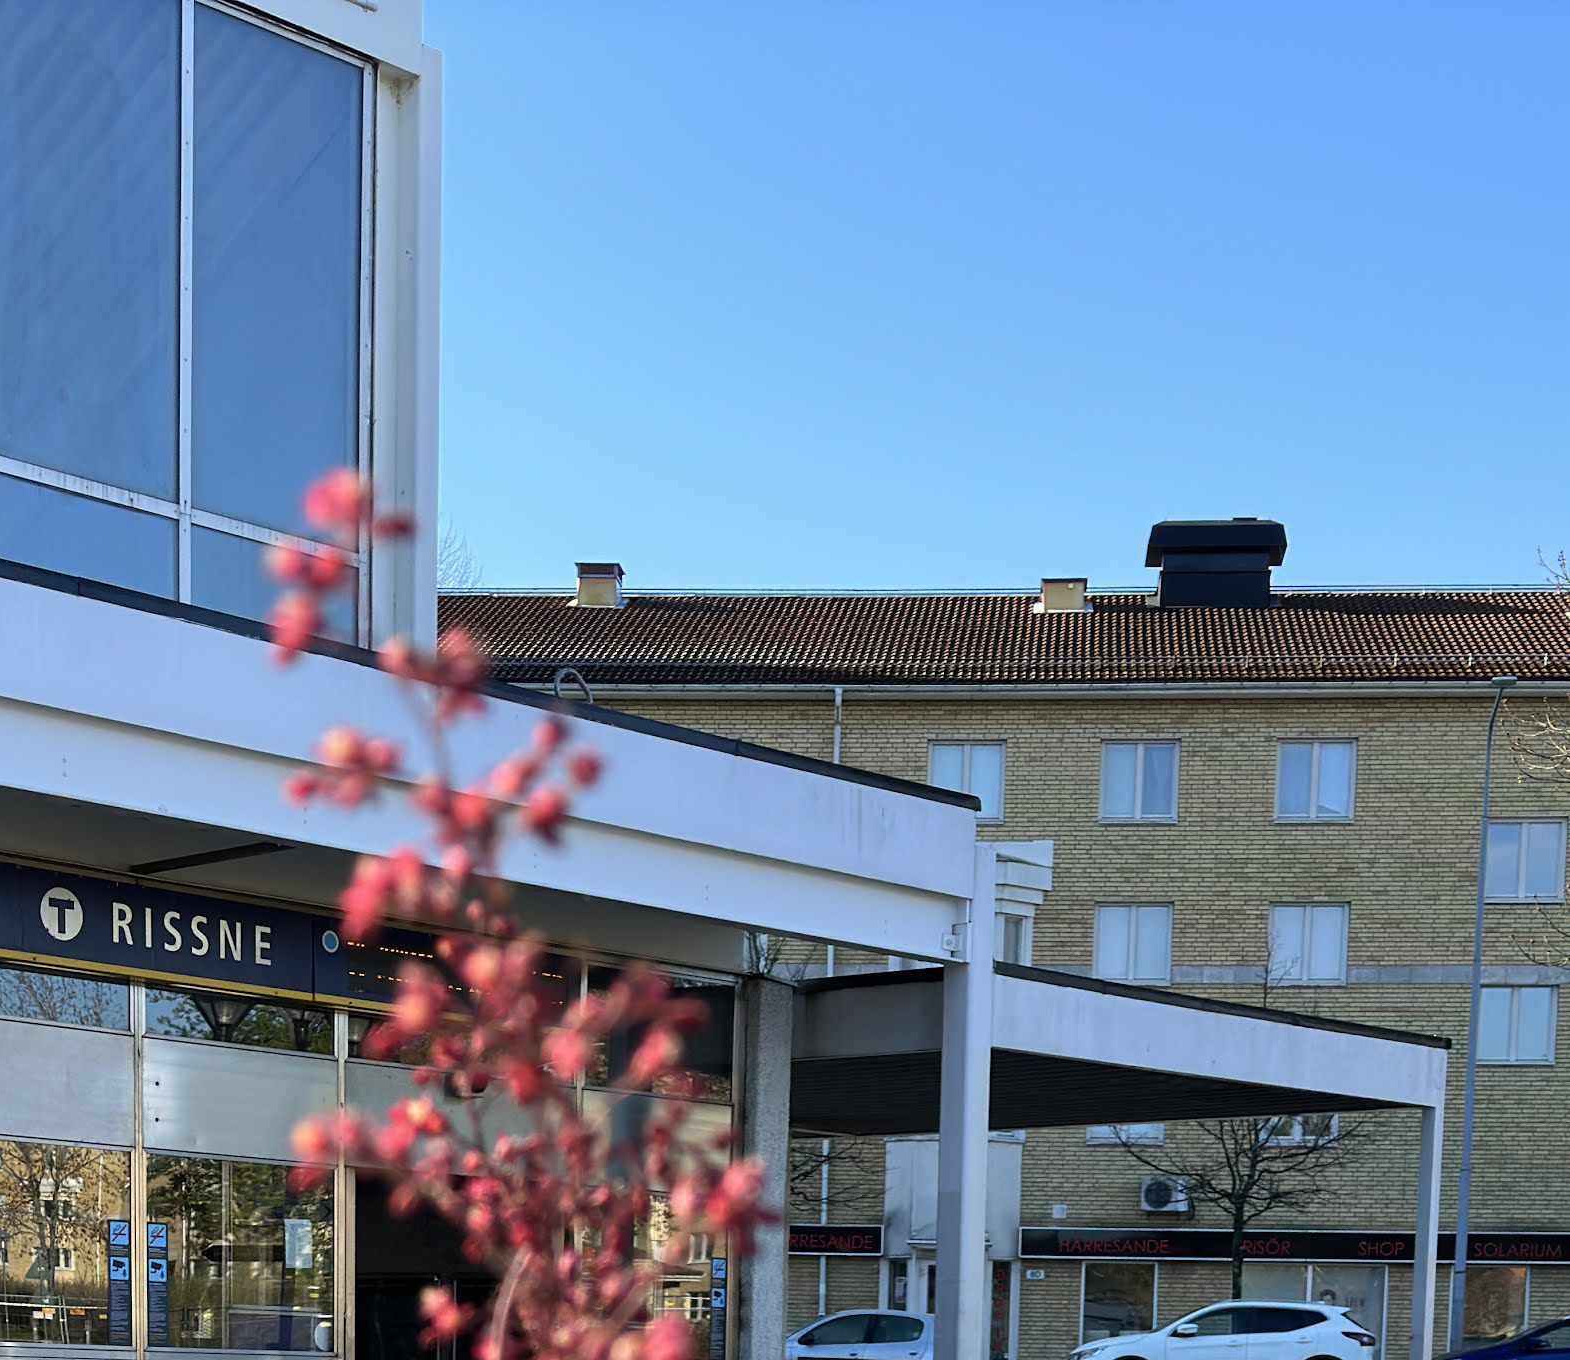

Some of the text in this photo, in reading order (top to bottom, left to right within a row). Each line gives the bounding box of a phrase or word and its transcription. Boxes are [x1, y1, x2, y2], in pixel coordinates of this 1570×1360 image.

[112, 902, 272, 966] RISSNE
[788, 1233, 875, 1250] RRESANDE
[1238, 1237, 1292, 1255] RISÖR
[1358, 1241, 1406, 1256] SHOP
[1473, 1242, 1563, 1258] SOLARIUM
